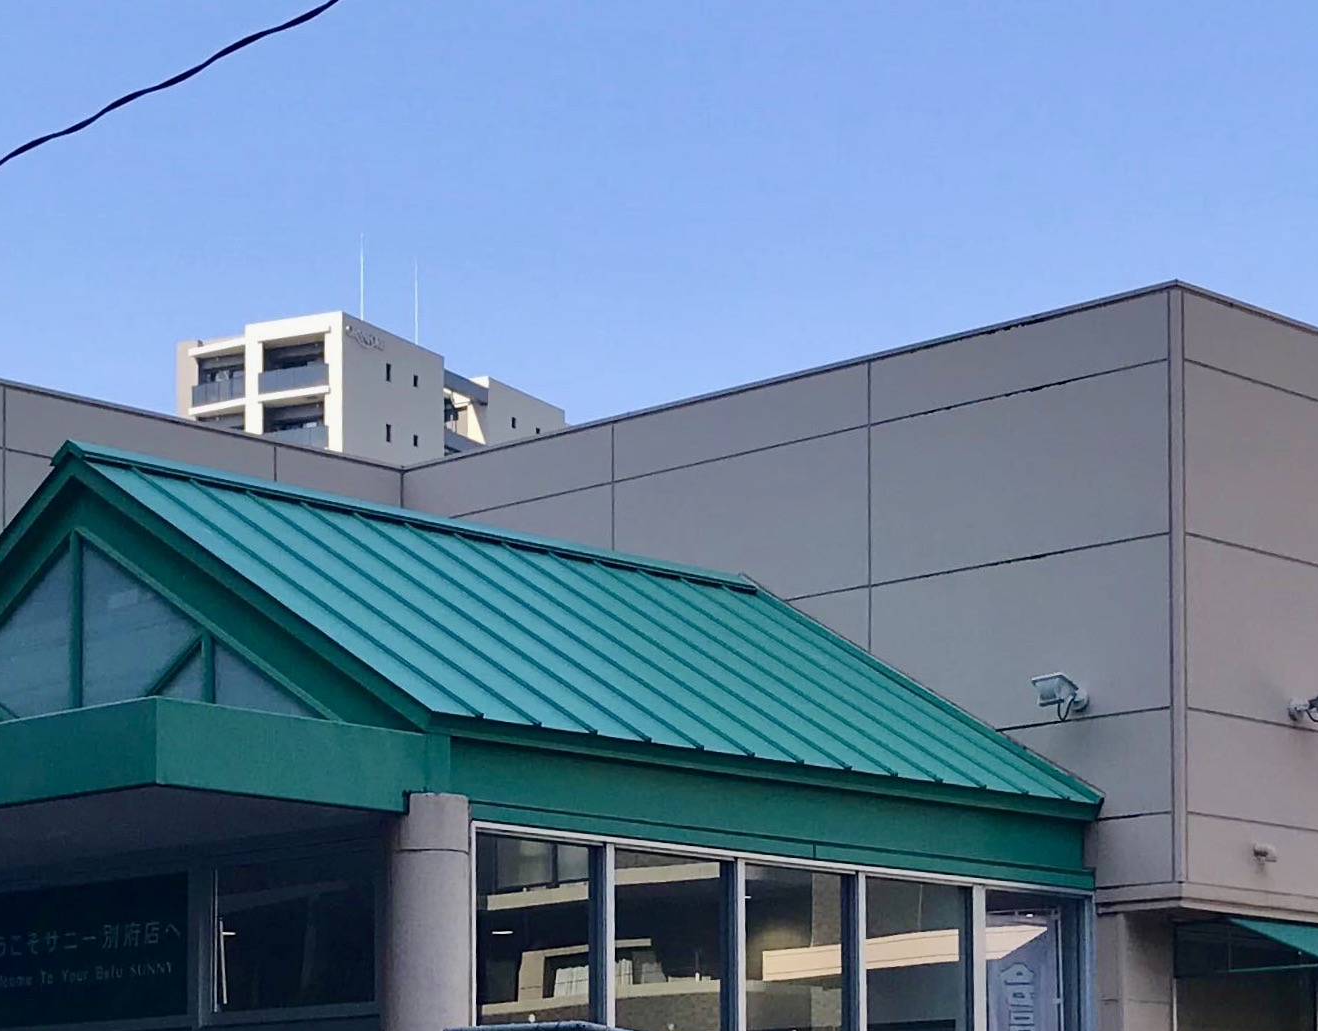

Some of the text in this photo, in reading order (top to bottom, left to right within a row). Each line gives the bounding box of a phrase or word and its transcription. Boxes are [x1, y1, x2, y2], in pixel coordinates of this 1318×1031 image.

[40, 970, 54, 985] To
[61, 968, 88, 983] Your
[130, 961, 173, 978] SUNNY
